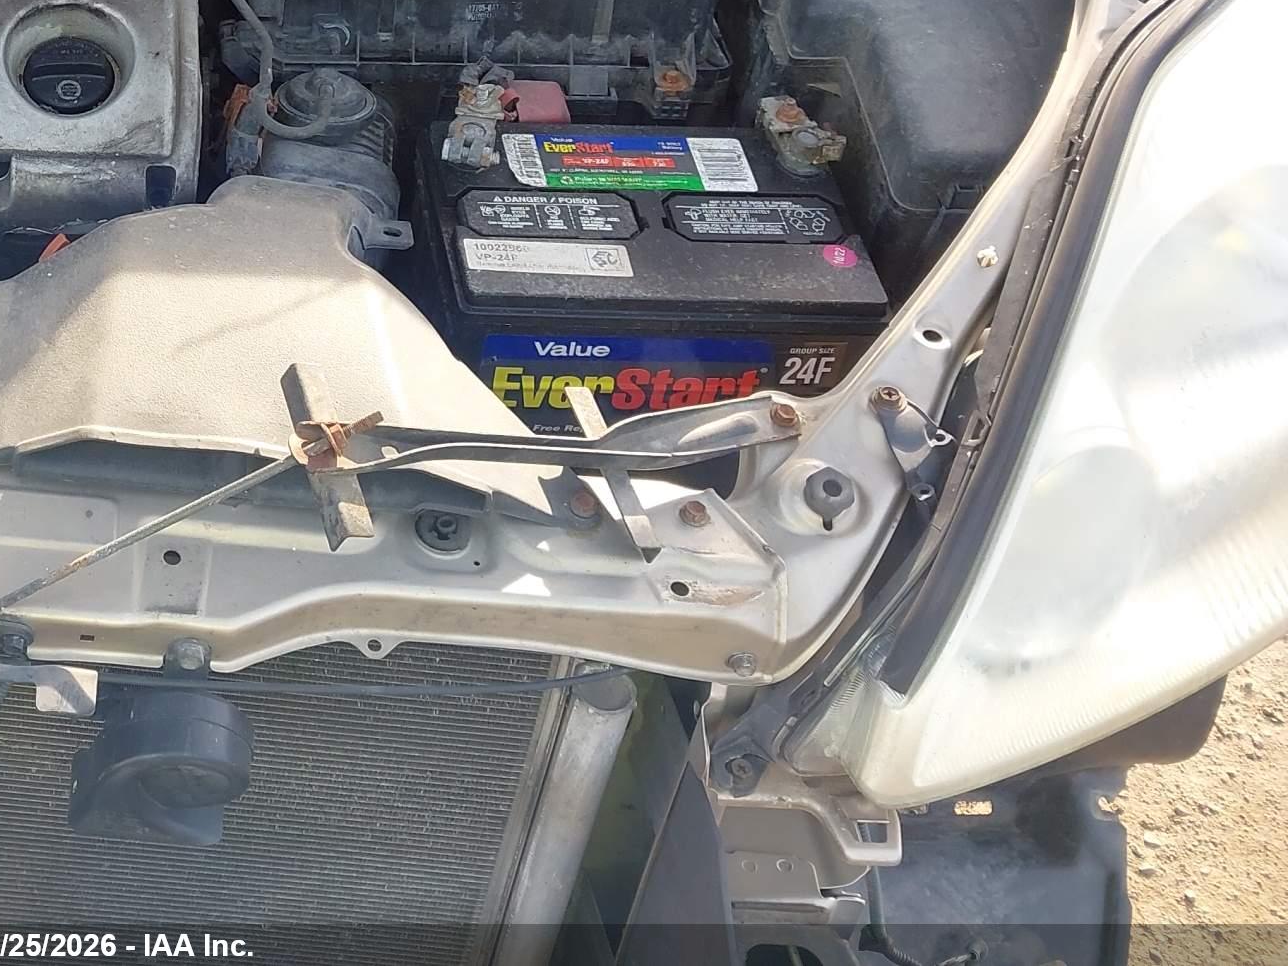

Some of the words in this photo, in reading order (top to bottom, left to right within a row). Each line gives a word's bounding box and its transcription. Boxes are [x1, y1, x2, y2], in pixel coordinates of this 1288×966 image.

[544, 141, 614, 154] EverStart
[558, 197, 598, 205] POISON
[534, 341, 611, 357] Value
[790, 347, 818, 355] GROUP
[778, 357, 836, 385] 24F
[532, 424, 561, 432] Free
